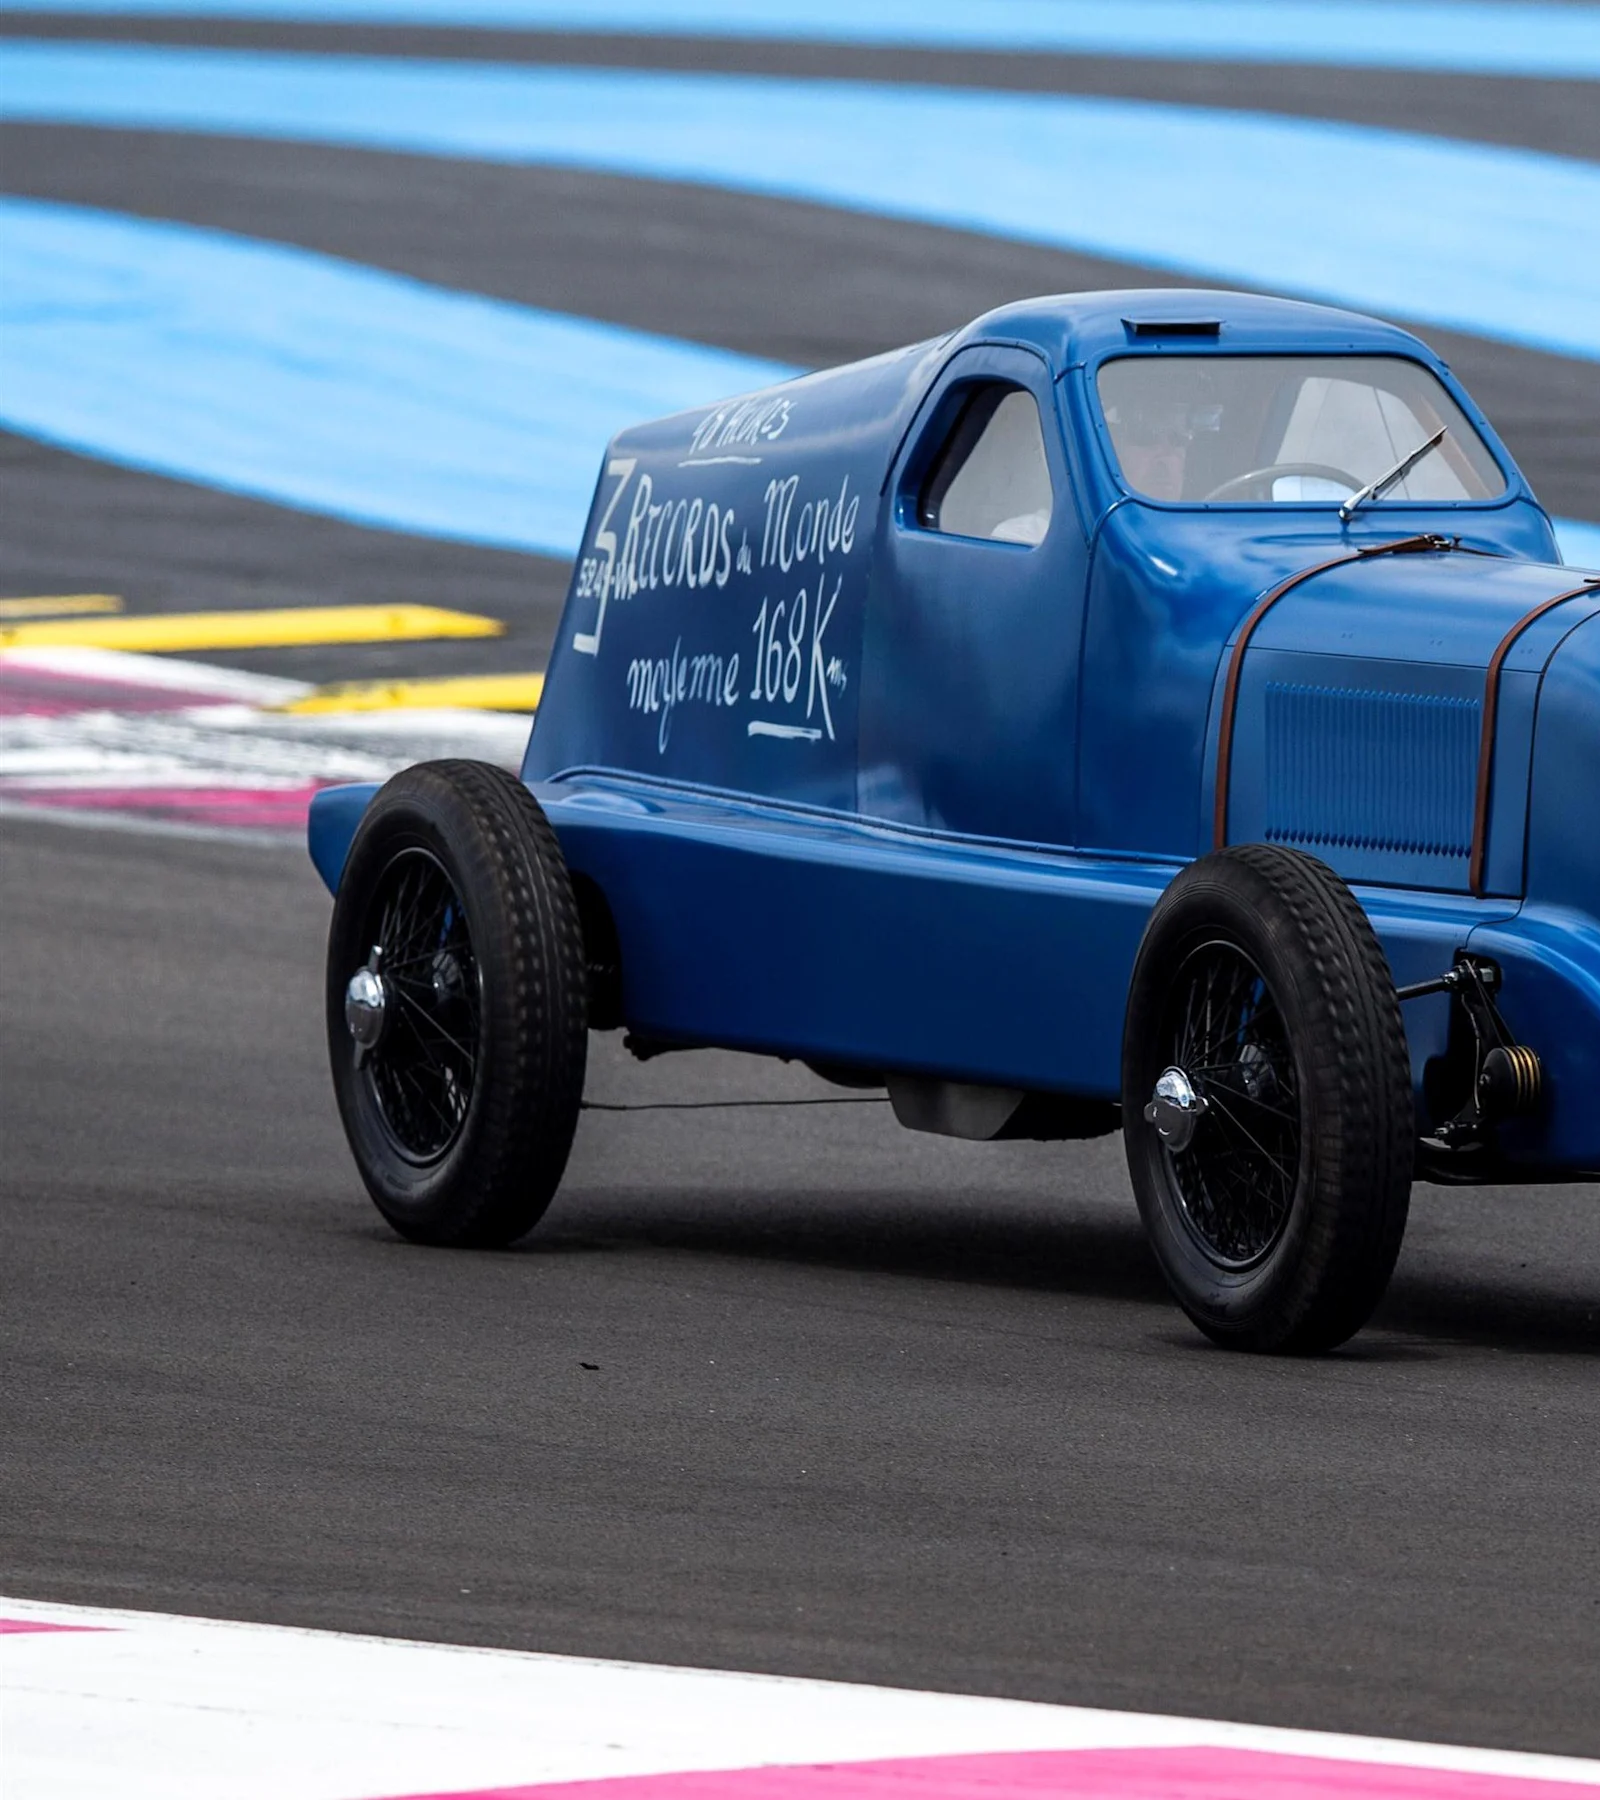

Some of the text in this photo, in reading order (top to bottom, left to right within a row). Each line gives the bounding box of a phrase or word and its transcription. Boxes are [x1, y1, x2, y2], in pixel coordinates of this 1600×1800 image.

[736, 528, 752, 575] du
[761, 474, 860, 573] Monde
[627, 635, 740, 755] moyenne
